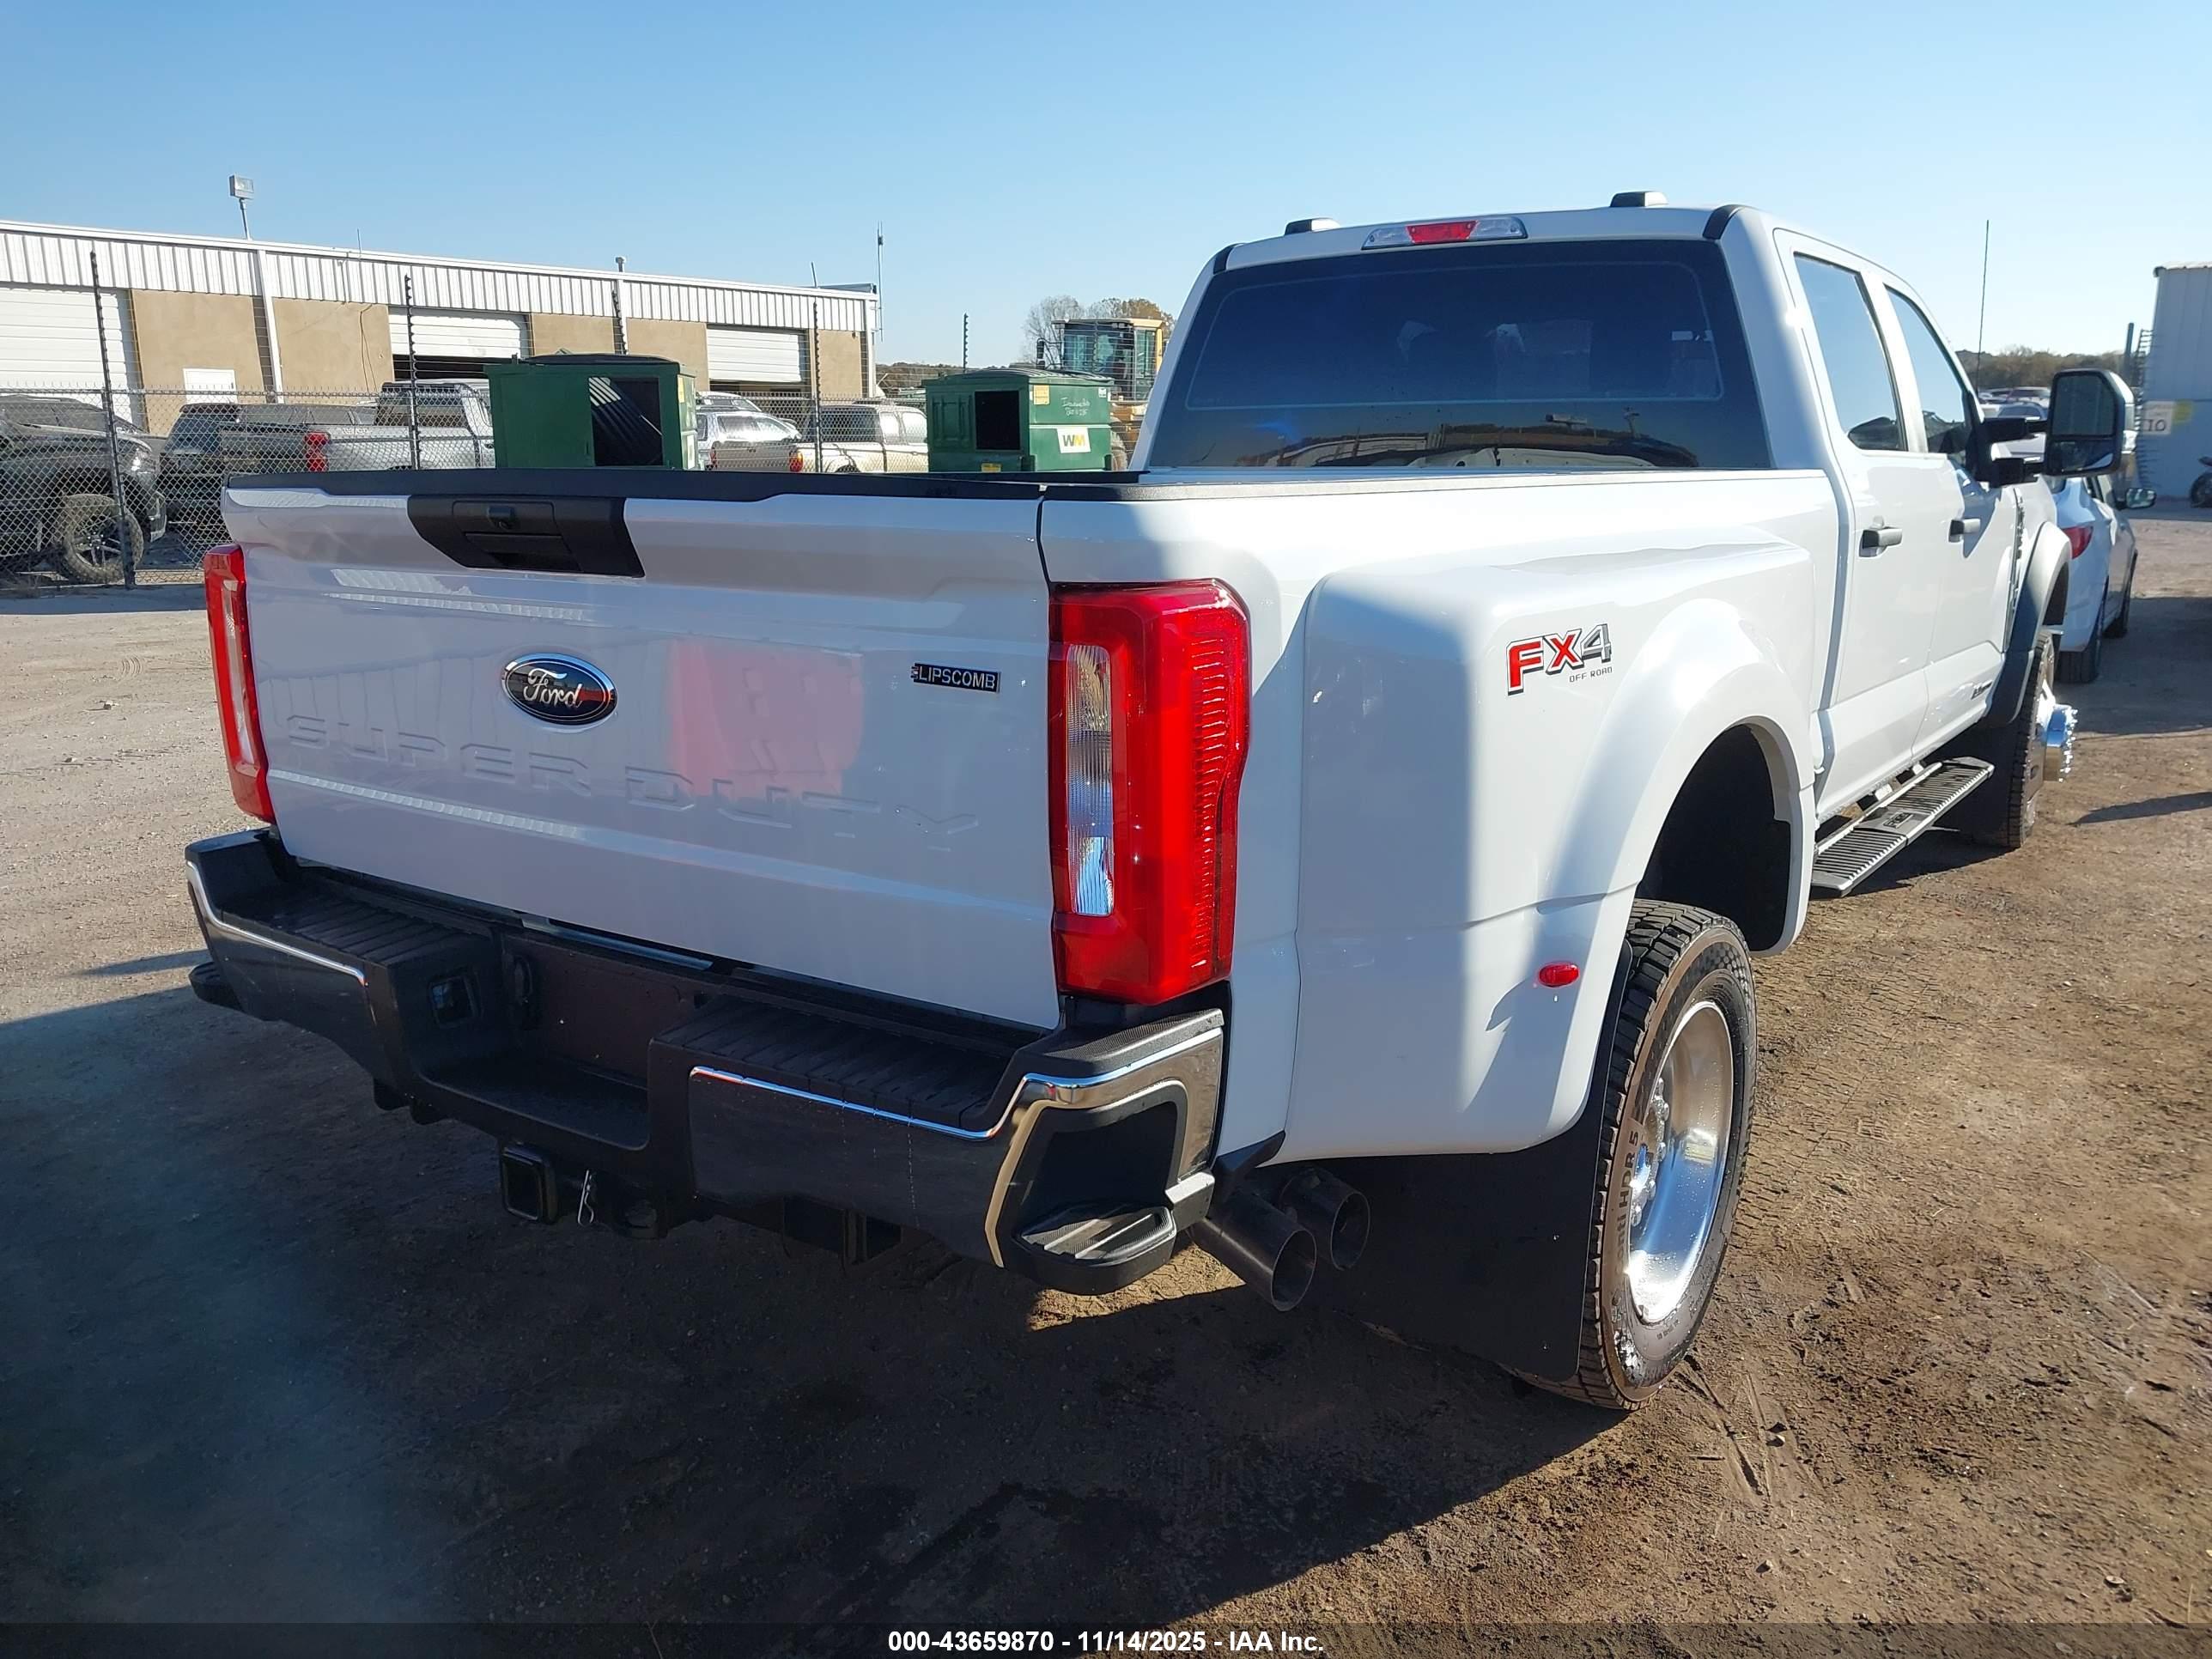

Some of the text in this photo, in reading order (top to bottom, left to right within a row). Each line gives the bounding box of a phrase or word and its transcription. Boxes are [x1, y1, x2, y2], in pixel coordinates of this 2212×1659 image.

[1062, 434, 1085, 447] WM
[918, 665, 996, 689] LIPSCOMB
[1506, 623, 1613, 696] FX4
[1569, 666, 1613, 684] OFF ROAD
[523, 667, 583, 708] Ford
[286, 714, 979, 853] SUPER DUTY
[1619, 1152, 1636, 1209] HDR
